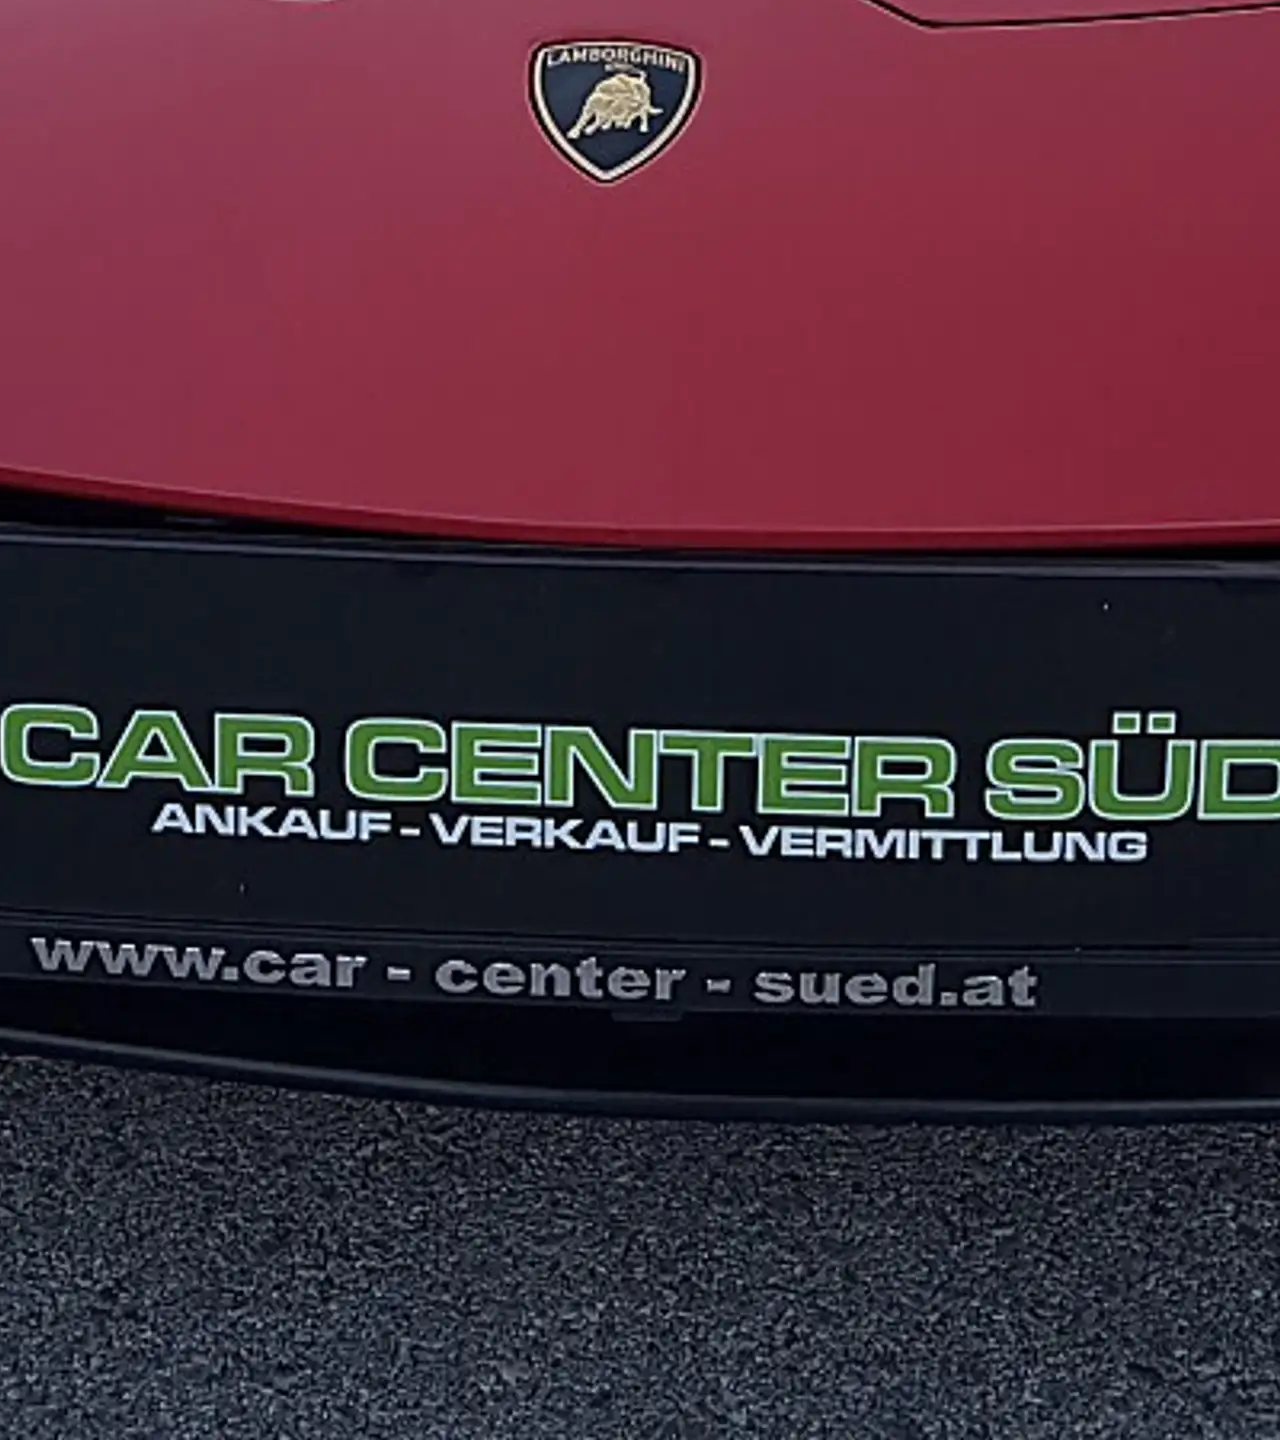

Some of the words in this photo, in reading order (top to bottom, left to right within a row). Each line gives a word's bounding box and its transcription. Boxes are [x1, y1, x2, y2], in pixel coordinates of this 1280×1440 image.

[546, 47, 686, 73] LAMBORGHINI
[343, 717, 959, 821] CENTER
[151, 802, 393, 842] ANKAUF
[429, 812, 702, 853] VERKAUF
[738, 824, 1148, 863] VERMITTLUNG
[29, 935, 369, 988] www.car
[435, 956, 687, 1001] center
[753, 962, 1039, 1007] sued.at
